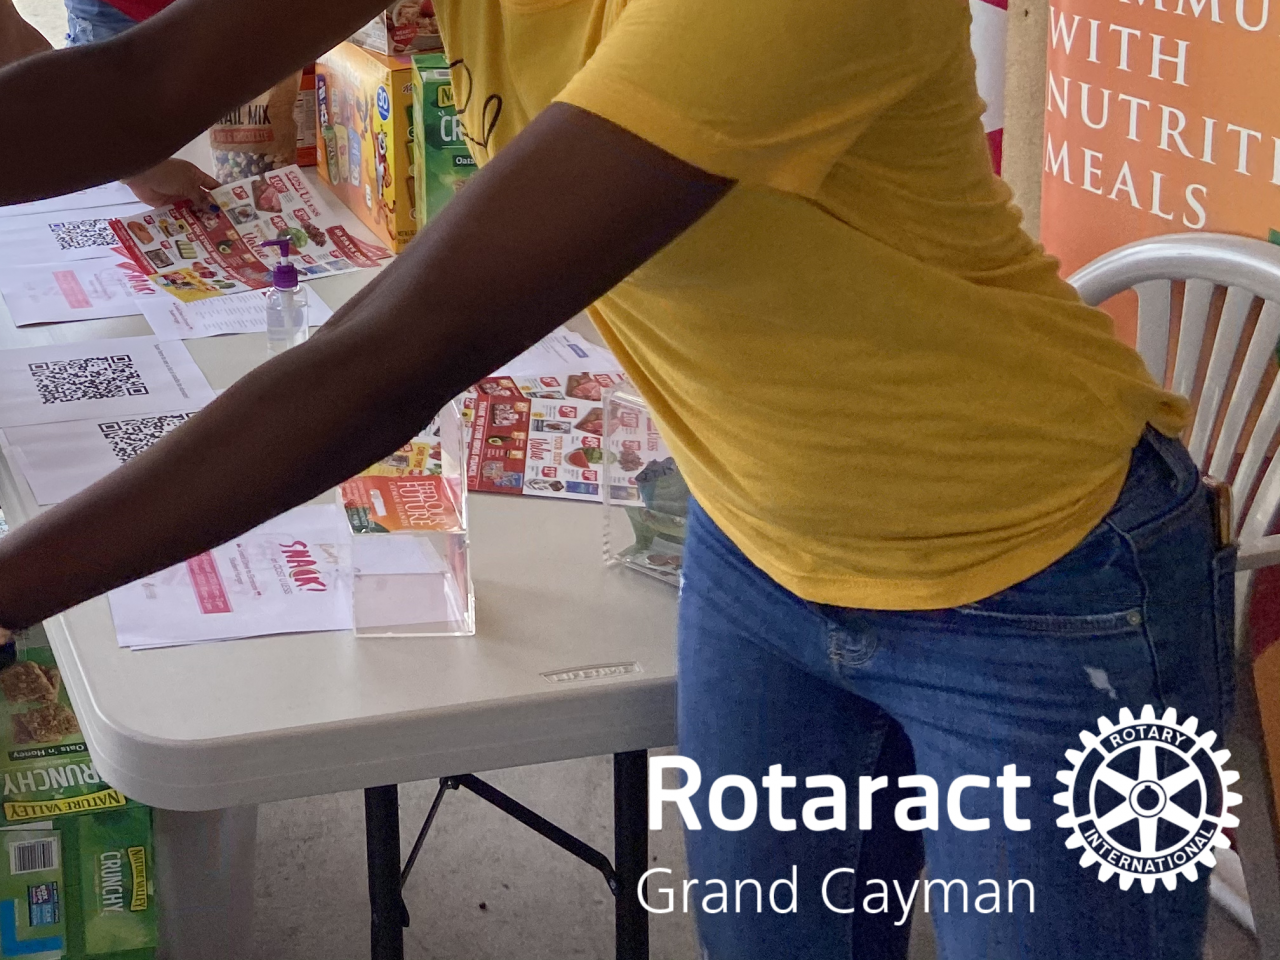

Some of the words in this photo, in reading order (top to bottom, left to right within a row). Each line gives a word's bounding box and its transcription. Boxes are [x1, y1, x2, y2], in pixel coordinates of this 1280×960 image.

[1049, 6, 1191, 87] WITH
[377, 91, 388, 108] 30
[248, 105, 271, 125] MIX
[1044, 133, 1208, 230] MEALS
[477, 401, 487, 417] THANK
[476, 417, 484, 425] YOU
[474, 426, 483, 438] STORE
[529, 438, 551, 462] Value
[554, 436, 562, 451] YOUR
[553, 452, 562, 465] BEST
[419, 480, 438, 502] FEED
[397, 481, 431, 527] FUTURE
[425, 501, 447, 526] OUR
[279, 540, 327, 592] SNACK!
[12, 748, 46, 758] Honey
[62, 744, 85, 752] Oats
[3, 762, 100, 796] RUNCHY
[10, 803, 61, 819] VALLEY
[64, 790, 120, 811] NATURE
[130, 849, 145, 880] NATURE
[100, 851, 124, 912] CRUNCHY
[132, 879, 146, 908] VALLEY
